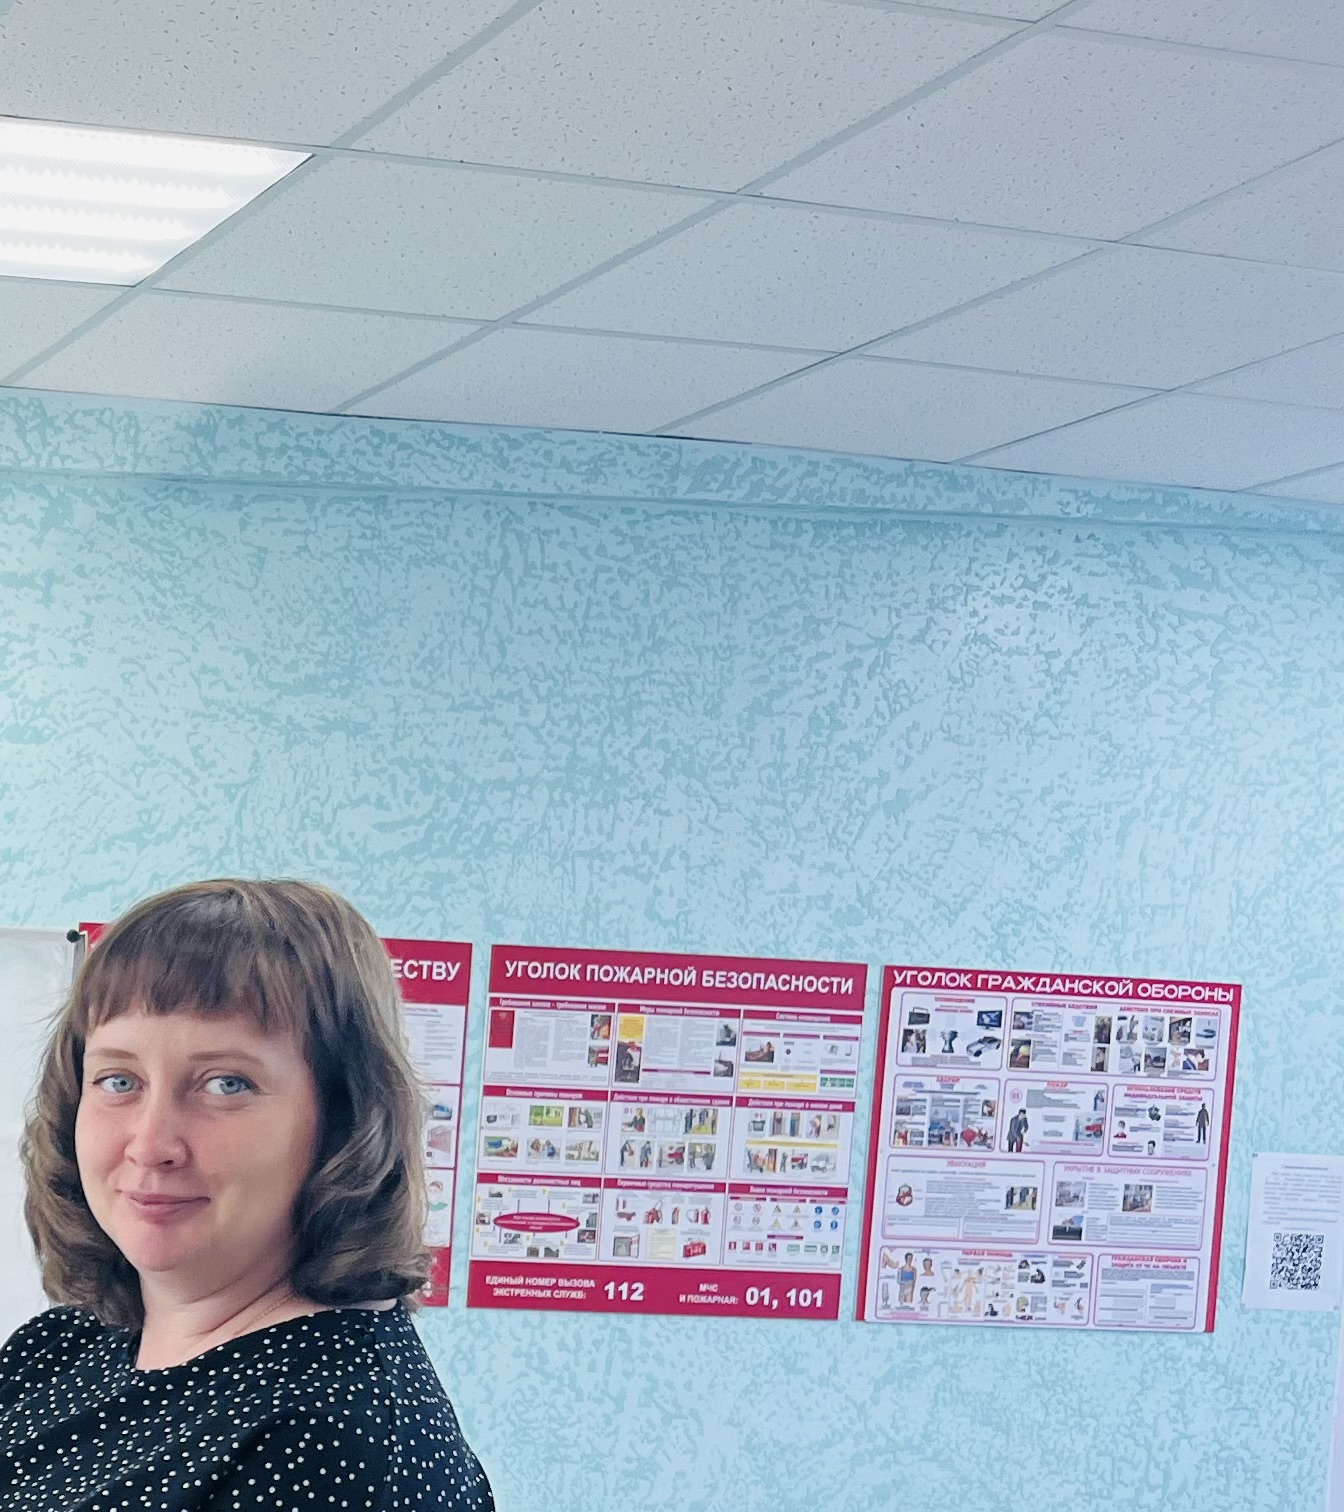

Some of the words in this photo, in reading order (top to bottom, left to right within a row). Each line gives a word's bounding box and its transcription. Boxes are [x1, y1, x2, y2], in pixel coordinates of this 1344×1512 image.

[391, 958, 461, 982] ЕСТВУ
[504, 960, 582, 982] УГОЛОК
[586, 964, 697, 987] ПОЖАРНОЙ
[702, 970, 853, 995] БЕЗОПАСНОСТИ
[893, 969, 973, 989] УГОЛОК
[976, 973, 1134, 997] ГРАЖДАНСКОЙ
[1137, 982, 1234, 1002] ОБОРОНЫ
[485, 1275, 524, 1285] ЕДИНЫЙ
[525, 1277, 556, 1287] НОМЕР
[558, 1278, 596, 1288] ВЫЗОВА
[493, 1287, 552, 1298] ЭКСТРЕННЫХ
[604, 1281, 645, 1301] 112
[745, 1286, 779, 1310] 01,
[786, 1287, 824, 1308] 101
